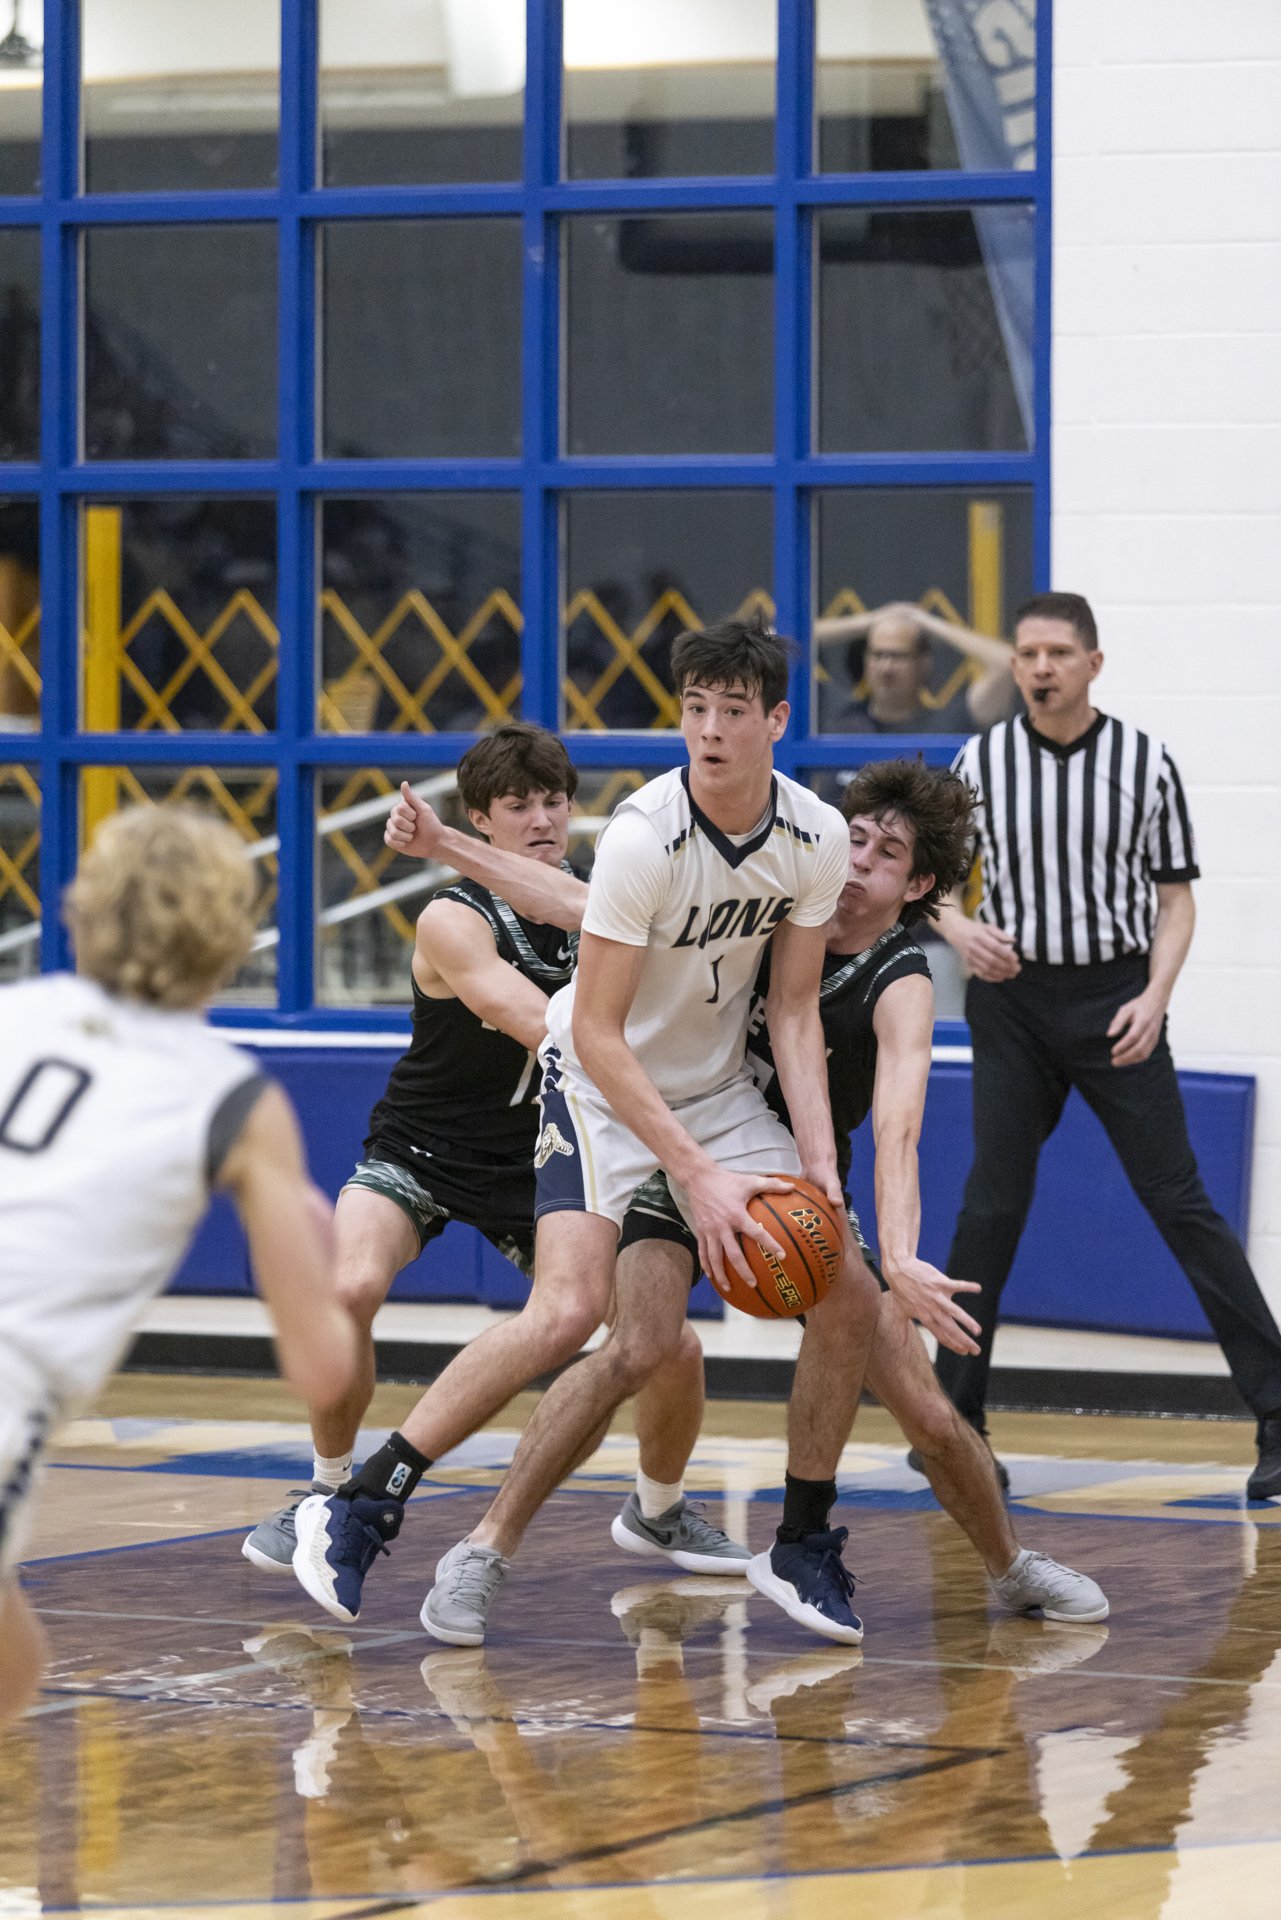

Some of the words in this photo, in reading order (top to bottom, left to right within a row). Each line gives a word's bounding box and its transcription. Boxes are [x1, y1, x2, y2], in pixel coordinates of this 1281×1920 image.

[670, 896, 795, 950] LIONS
[704, 954, 725, 1004] 1
[0, 1056, 93, 1155] 0
[787, 1207, 840, 1285] Baden
